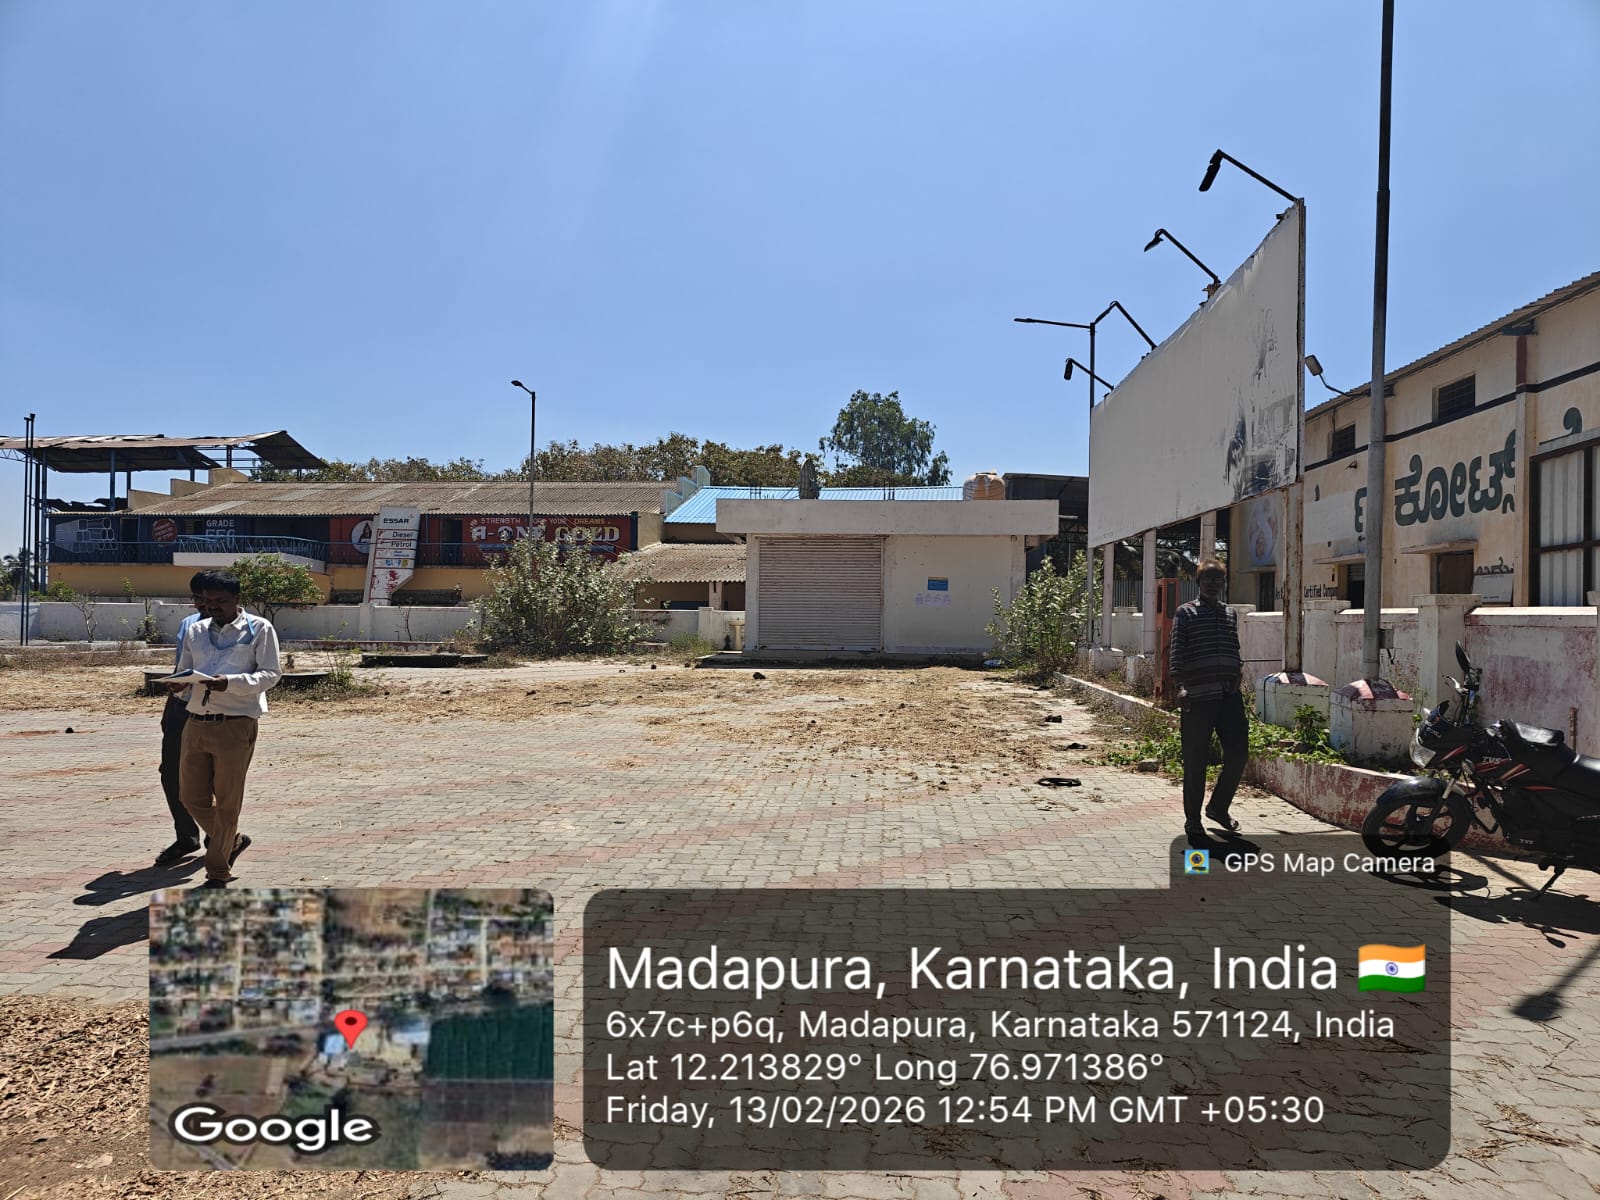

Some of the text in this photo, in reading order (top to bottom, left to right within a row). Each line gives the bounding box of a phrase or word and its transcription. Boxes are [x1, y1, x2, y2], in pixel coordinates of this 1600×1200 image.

[206, 519, 235, 528] GRADE
[480, 517, 521, 525] STRENGTH
[554, 526, 620, 542] GOLD
[1483, 756, 1501, 764] TVS
